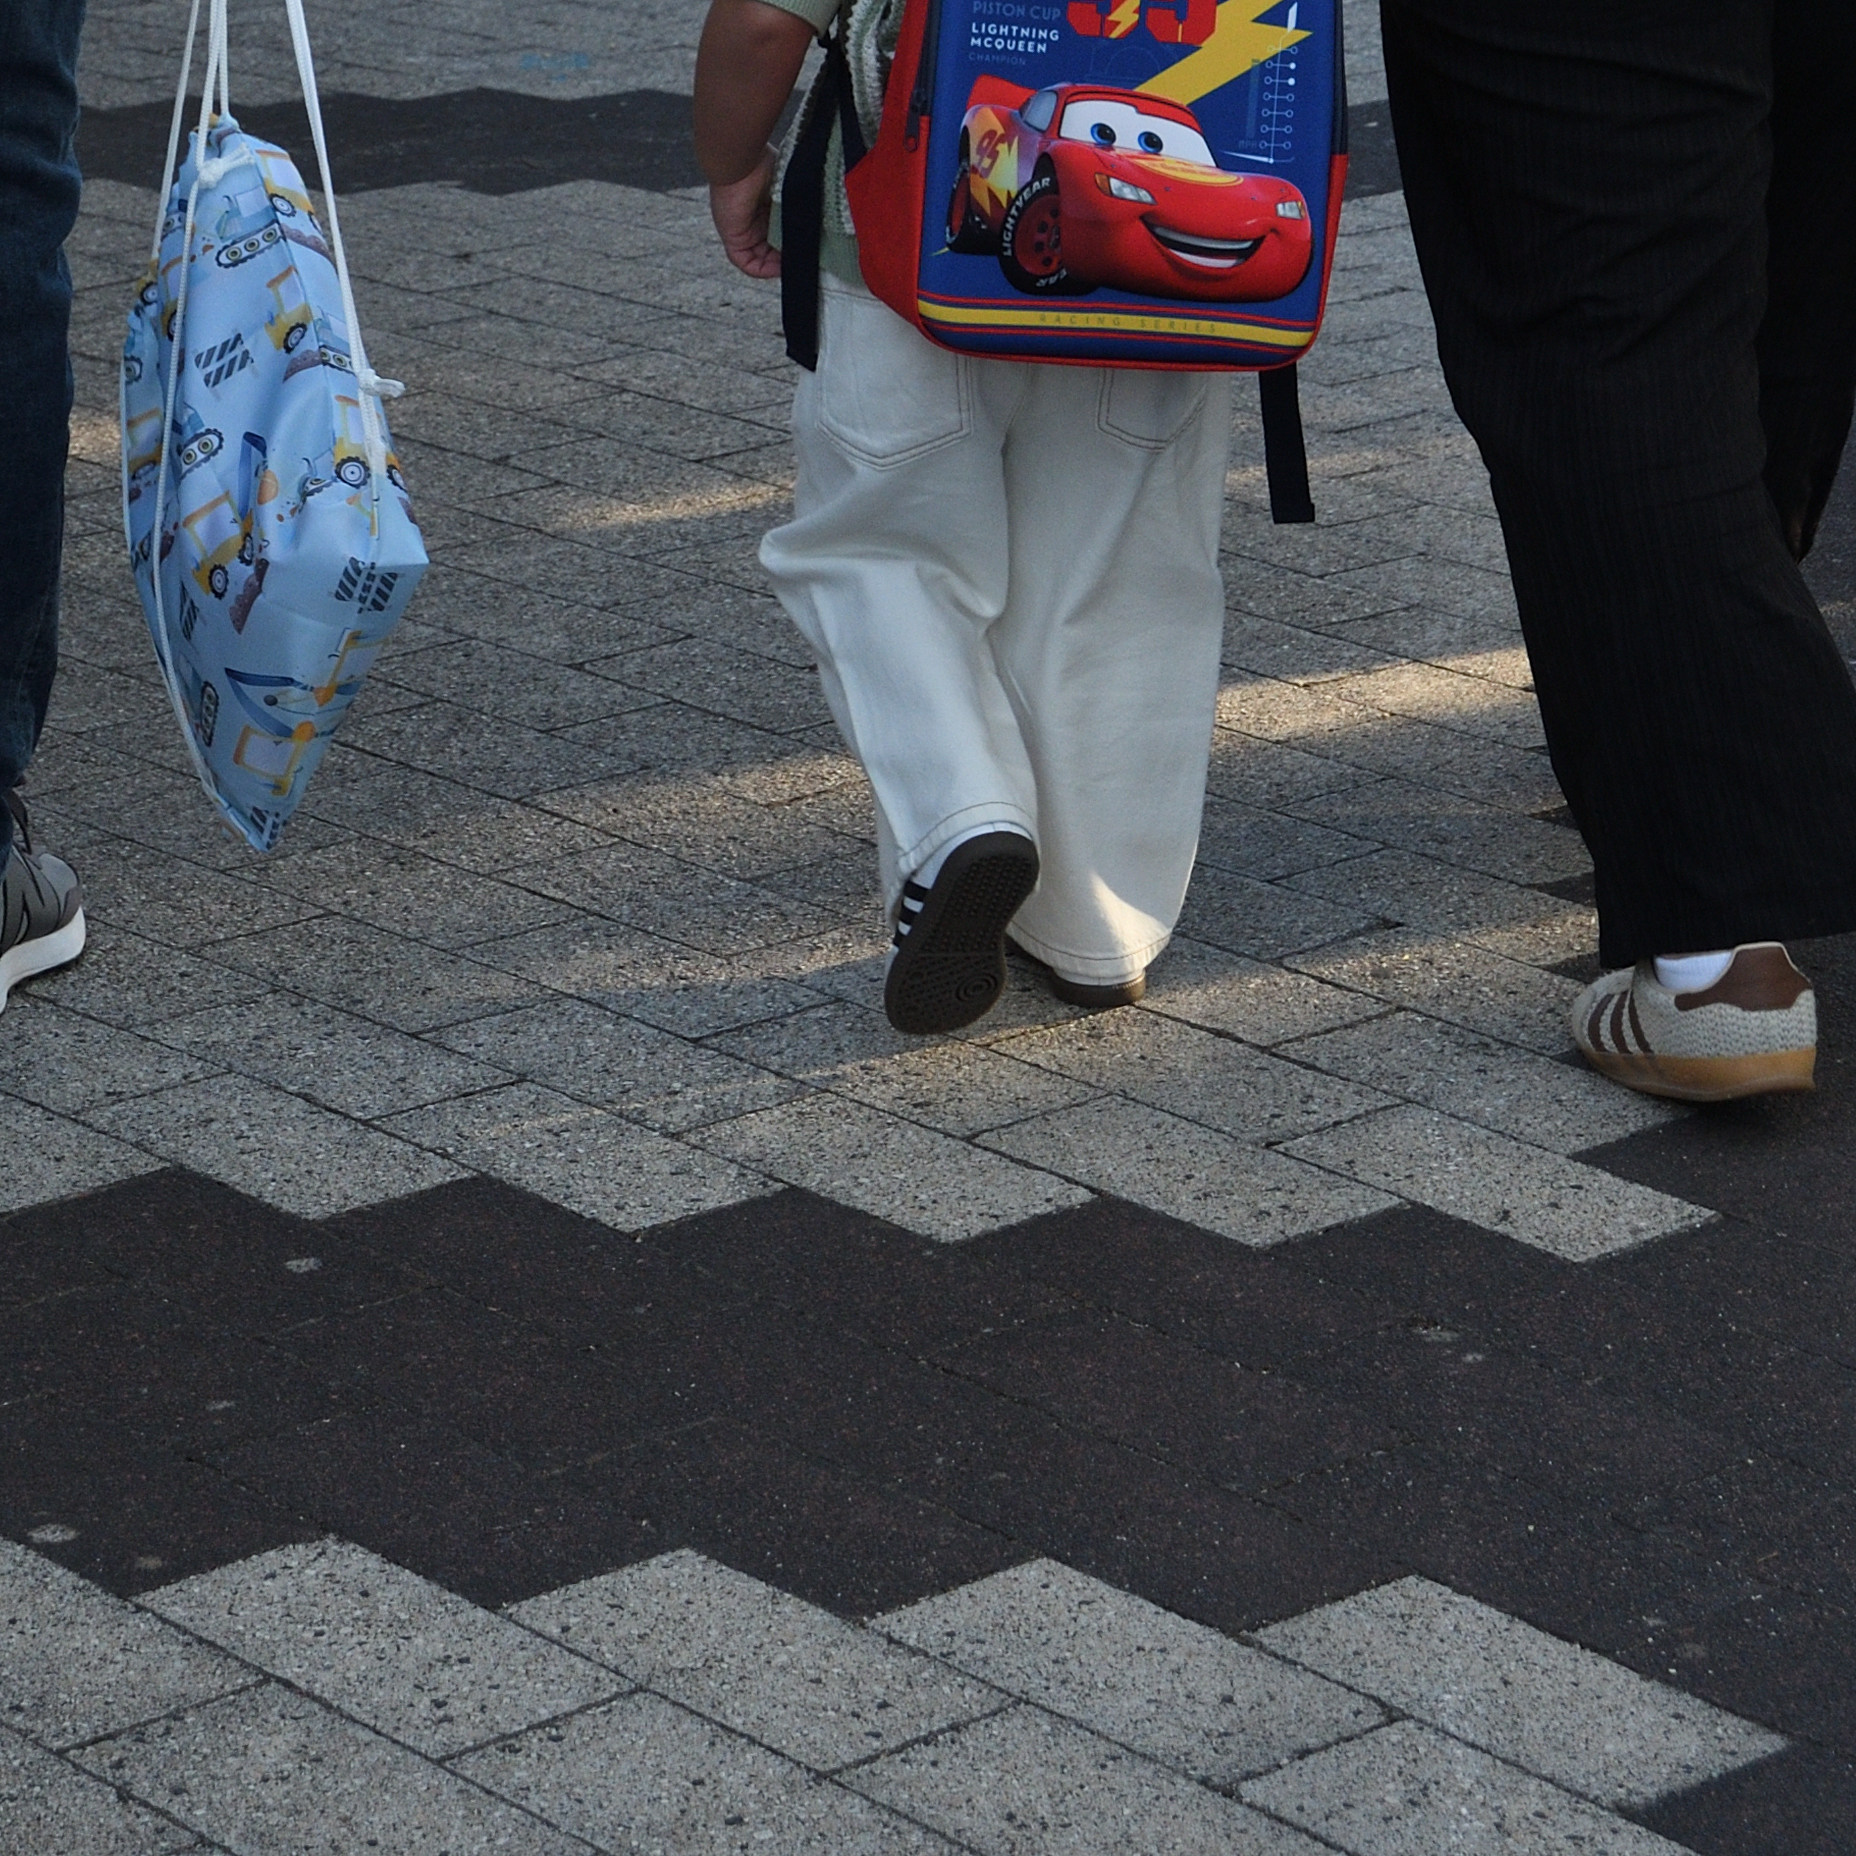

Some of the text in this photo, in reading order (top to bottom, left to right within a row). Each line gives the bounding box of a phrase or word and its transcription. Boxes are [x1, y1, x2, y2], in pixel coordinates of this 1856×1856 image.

[972, 0, 1061, 21] PISTON CUP
[971, 22, 1060, 42] LIGHTNING
[970, 37, 1047, 54] MCQUEEN
[968, 52, 1027, 66] CHAMPION
[1002, 177, 1051, 257] LIGHTYEAR
[1039, 313, 1216, 333] RACING SERIES
